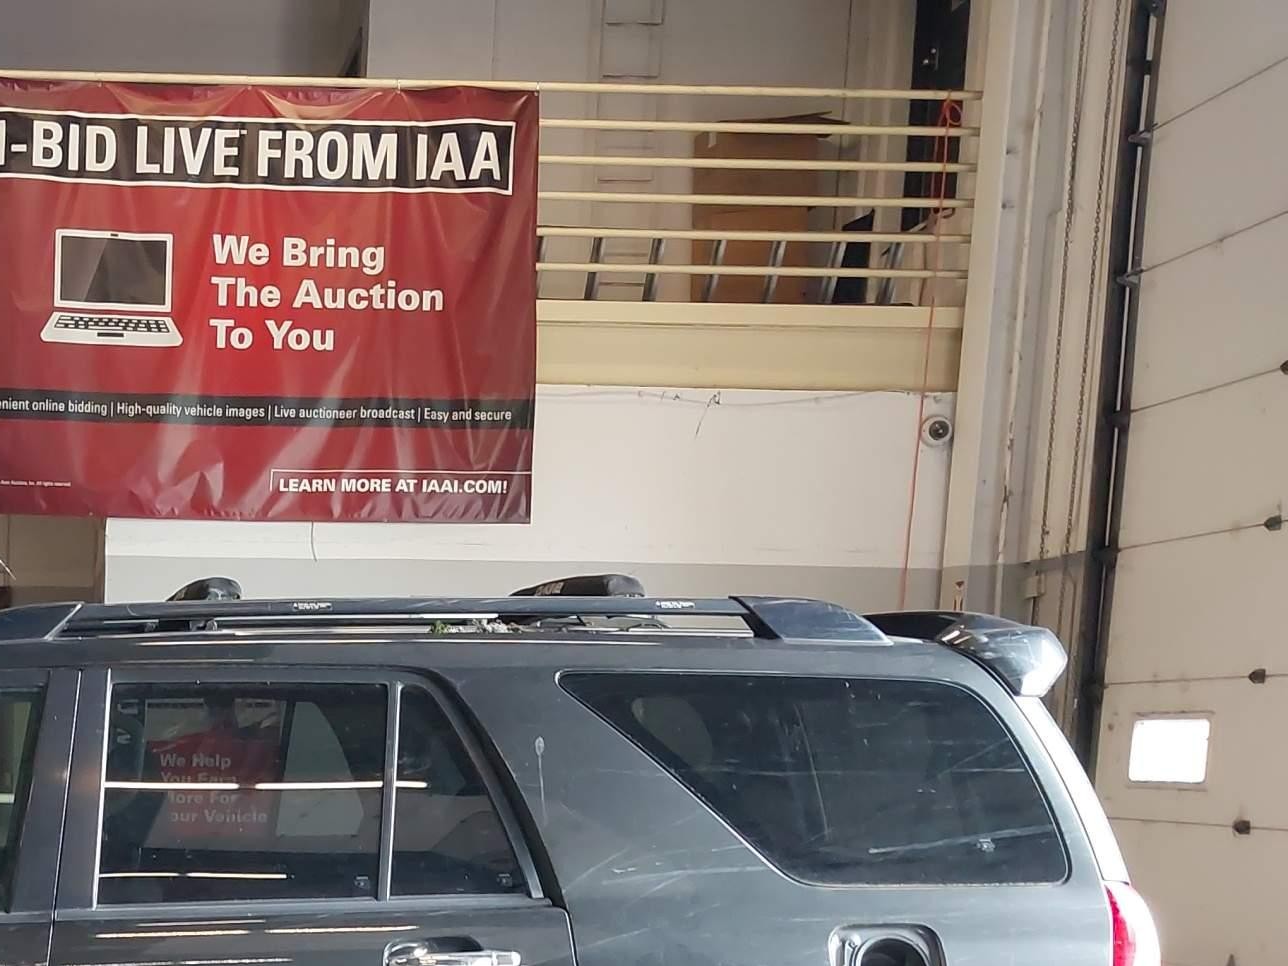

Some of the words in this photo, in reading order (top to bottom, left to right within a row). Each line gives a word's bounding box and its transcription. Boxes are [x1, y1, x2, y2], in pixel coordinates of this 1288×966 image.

[135, 125, 241, 176] LIVE
[257, 130, 398, 180] FROM
[415, 131, 502, 181] IAA
[213, 234, 270, 266] We
[283, 237, 385, 275] Bring
[210, 277, 281, 308] The
[292, 279, 444, 311] Auction
[209, 319, 253, 349] To
[265, 320, 335, 351] You
[32, 399, 65, 412] online
[68, 400, 108, 416] bidding
[116, 402, 182, 418] High-quality
[184, 403, 223, 417] vehicle
[225, 405, 265, 419] images
[274, 405, 296, 418] Live
[299, 406, 357, 420] auctioneer
[360, 406, 415, 420] broadcast
[424, 407, 449, 422] Easy
[452, 407, 472, 421] and
[474, 409, 512, 421] secure
[279, 478, 336, 492] LEARN
[341, 478, 391, 492] MORE
[395, 478, 418, 492] AT
[422, 479, 508, 494] IAAI.COM!
